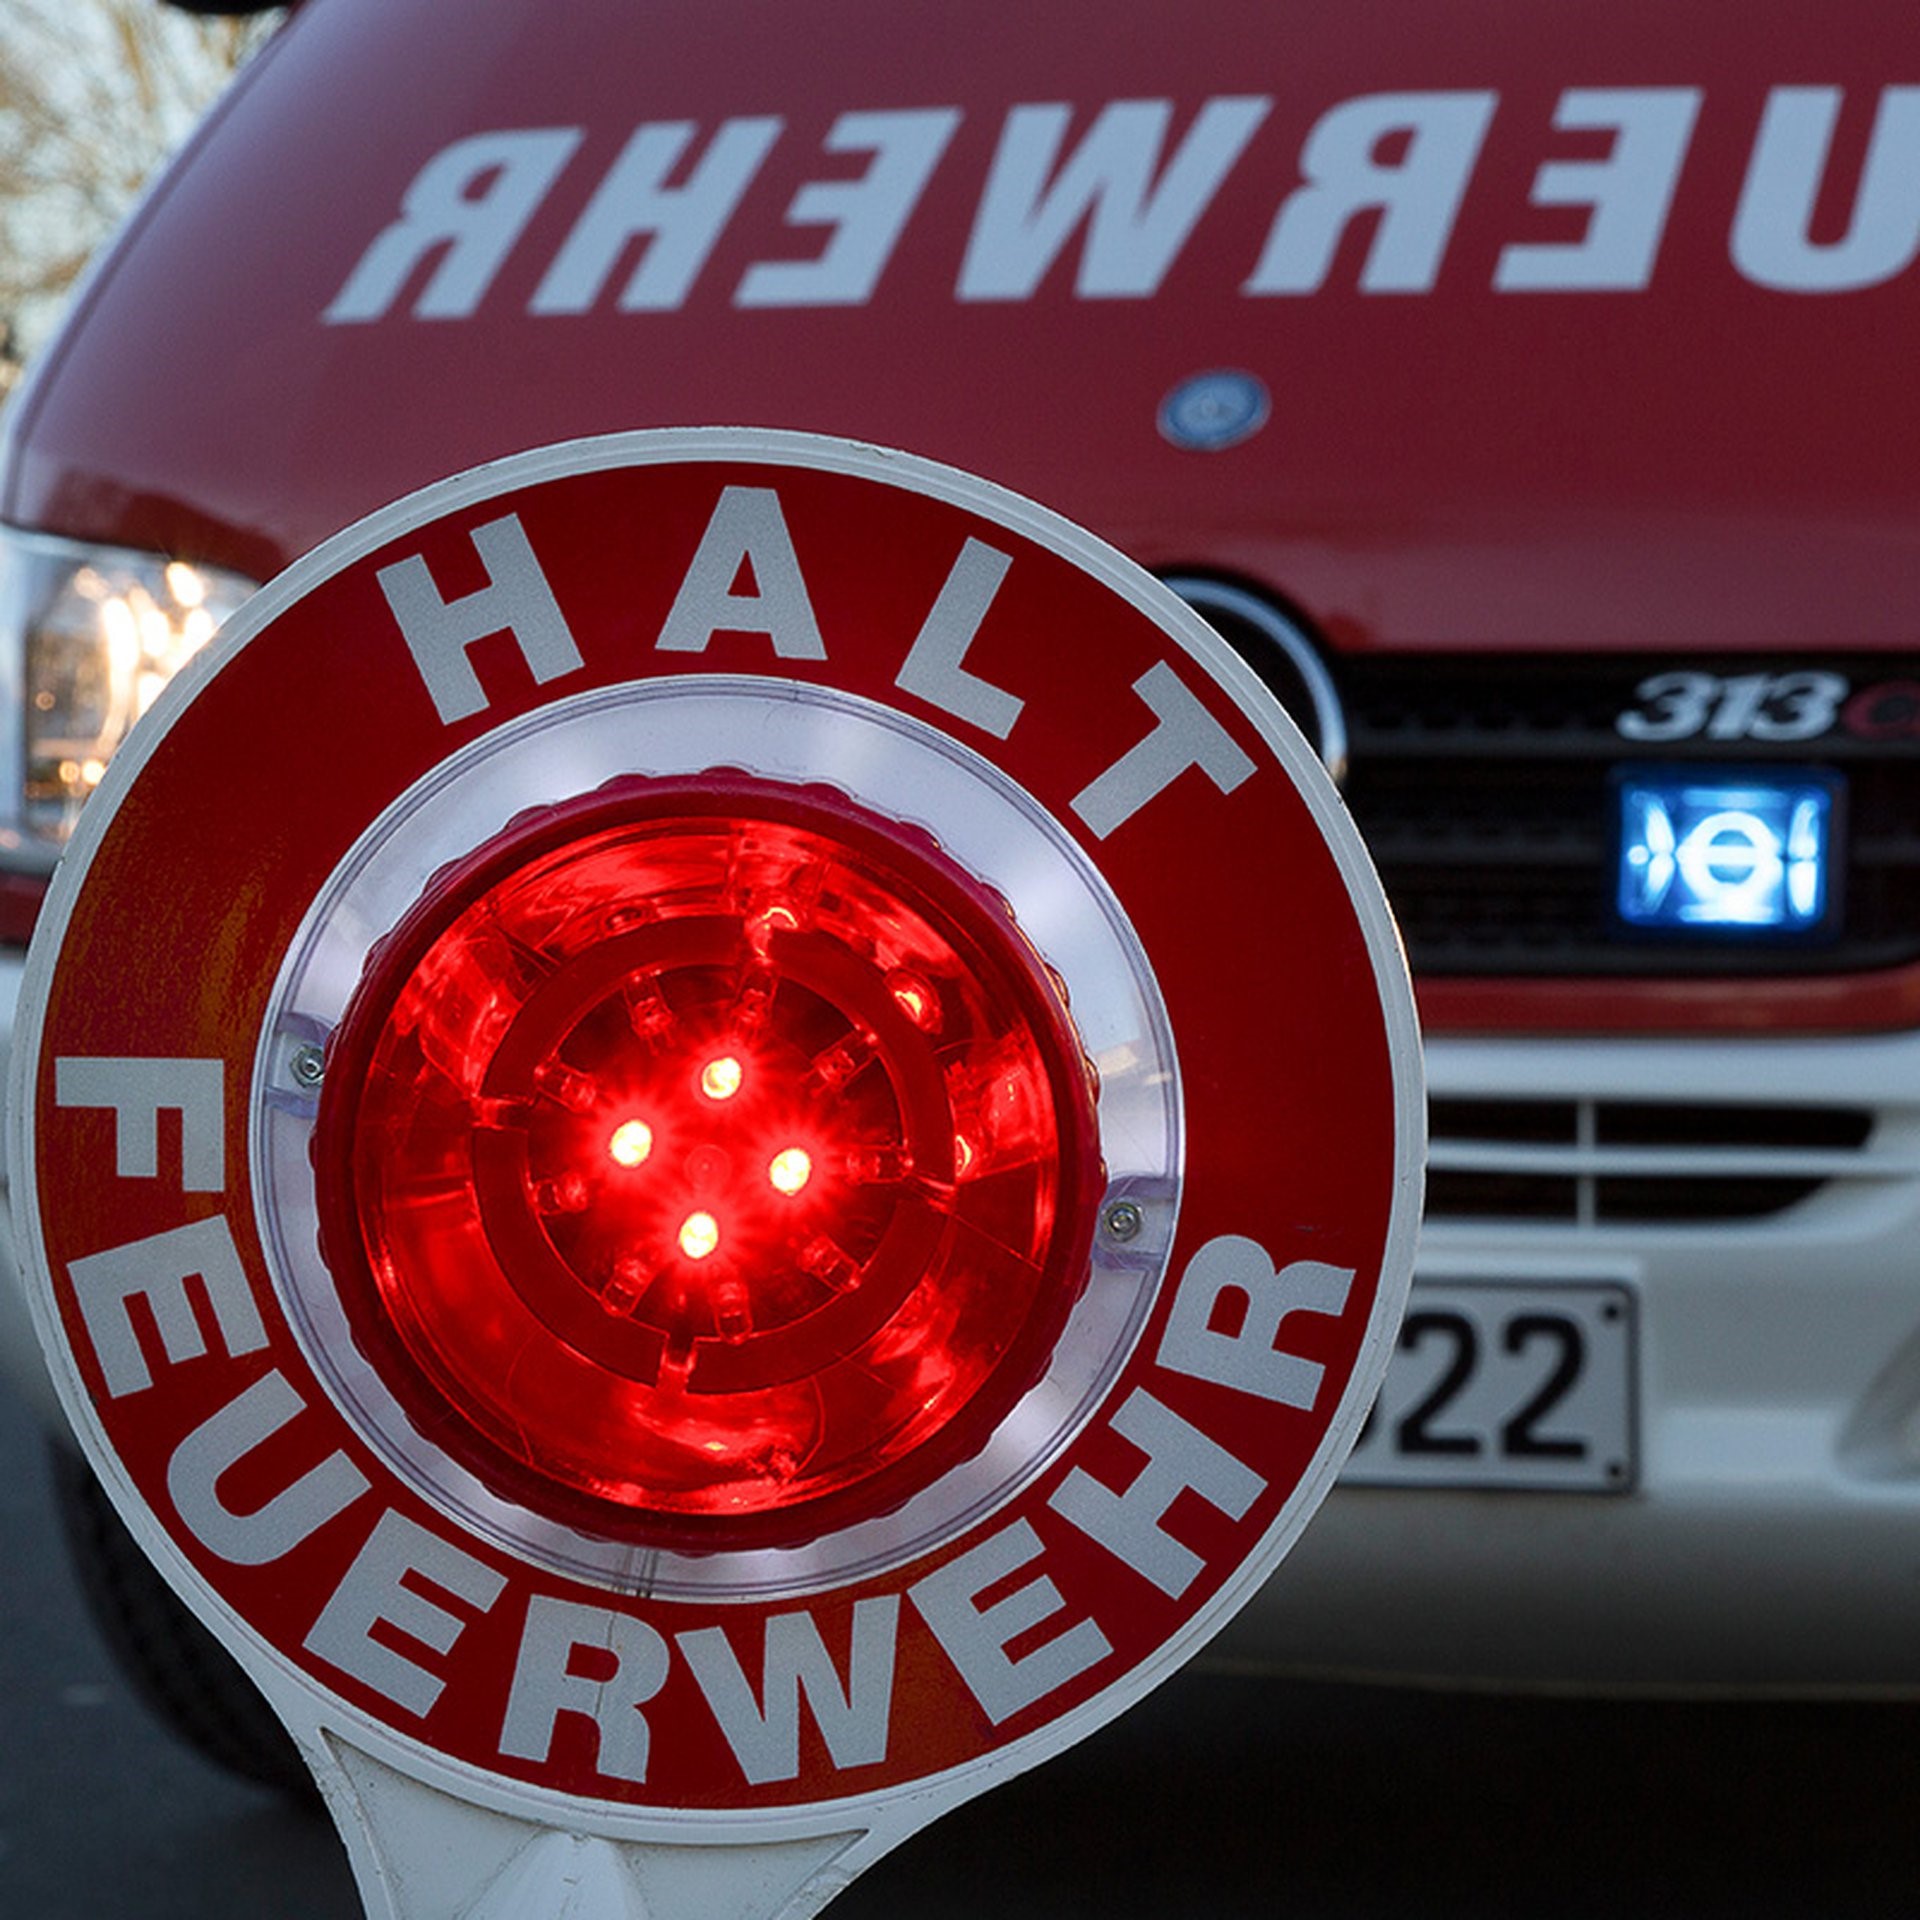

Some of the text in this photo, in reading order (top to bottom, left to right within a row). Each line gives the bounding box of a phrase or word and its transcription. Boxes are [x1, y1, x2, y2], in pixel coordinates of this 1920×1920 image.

[375, 485, 1258, 841] HALT
[1615, 670, 1849, 741] 313
[55, 1056, 1357, 1786] FEUERWEHR
[1353, 1310, 1587, 1457] 22
